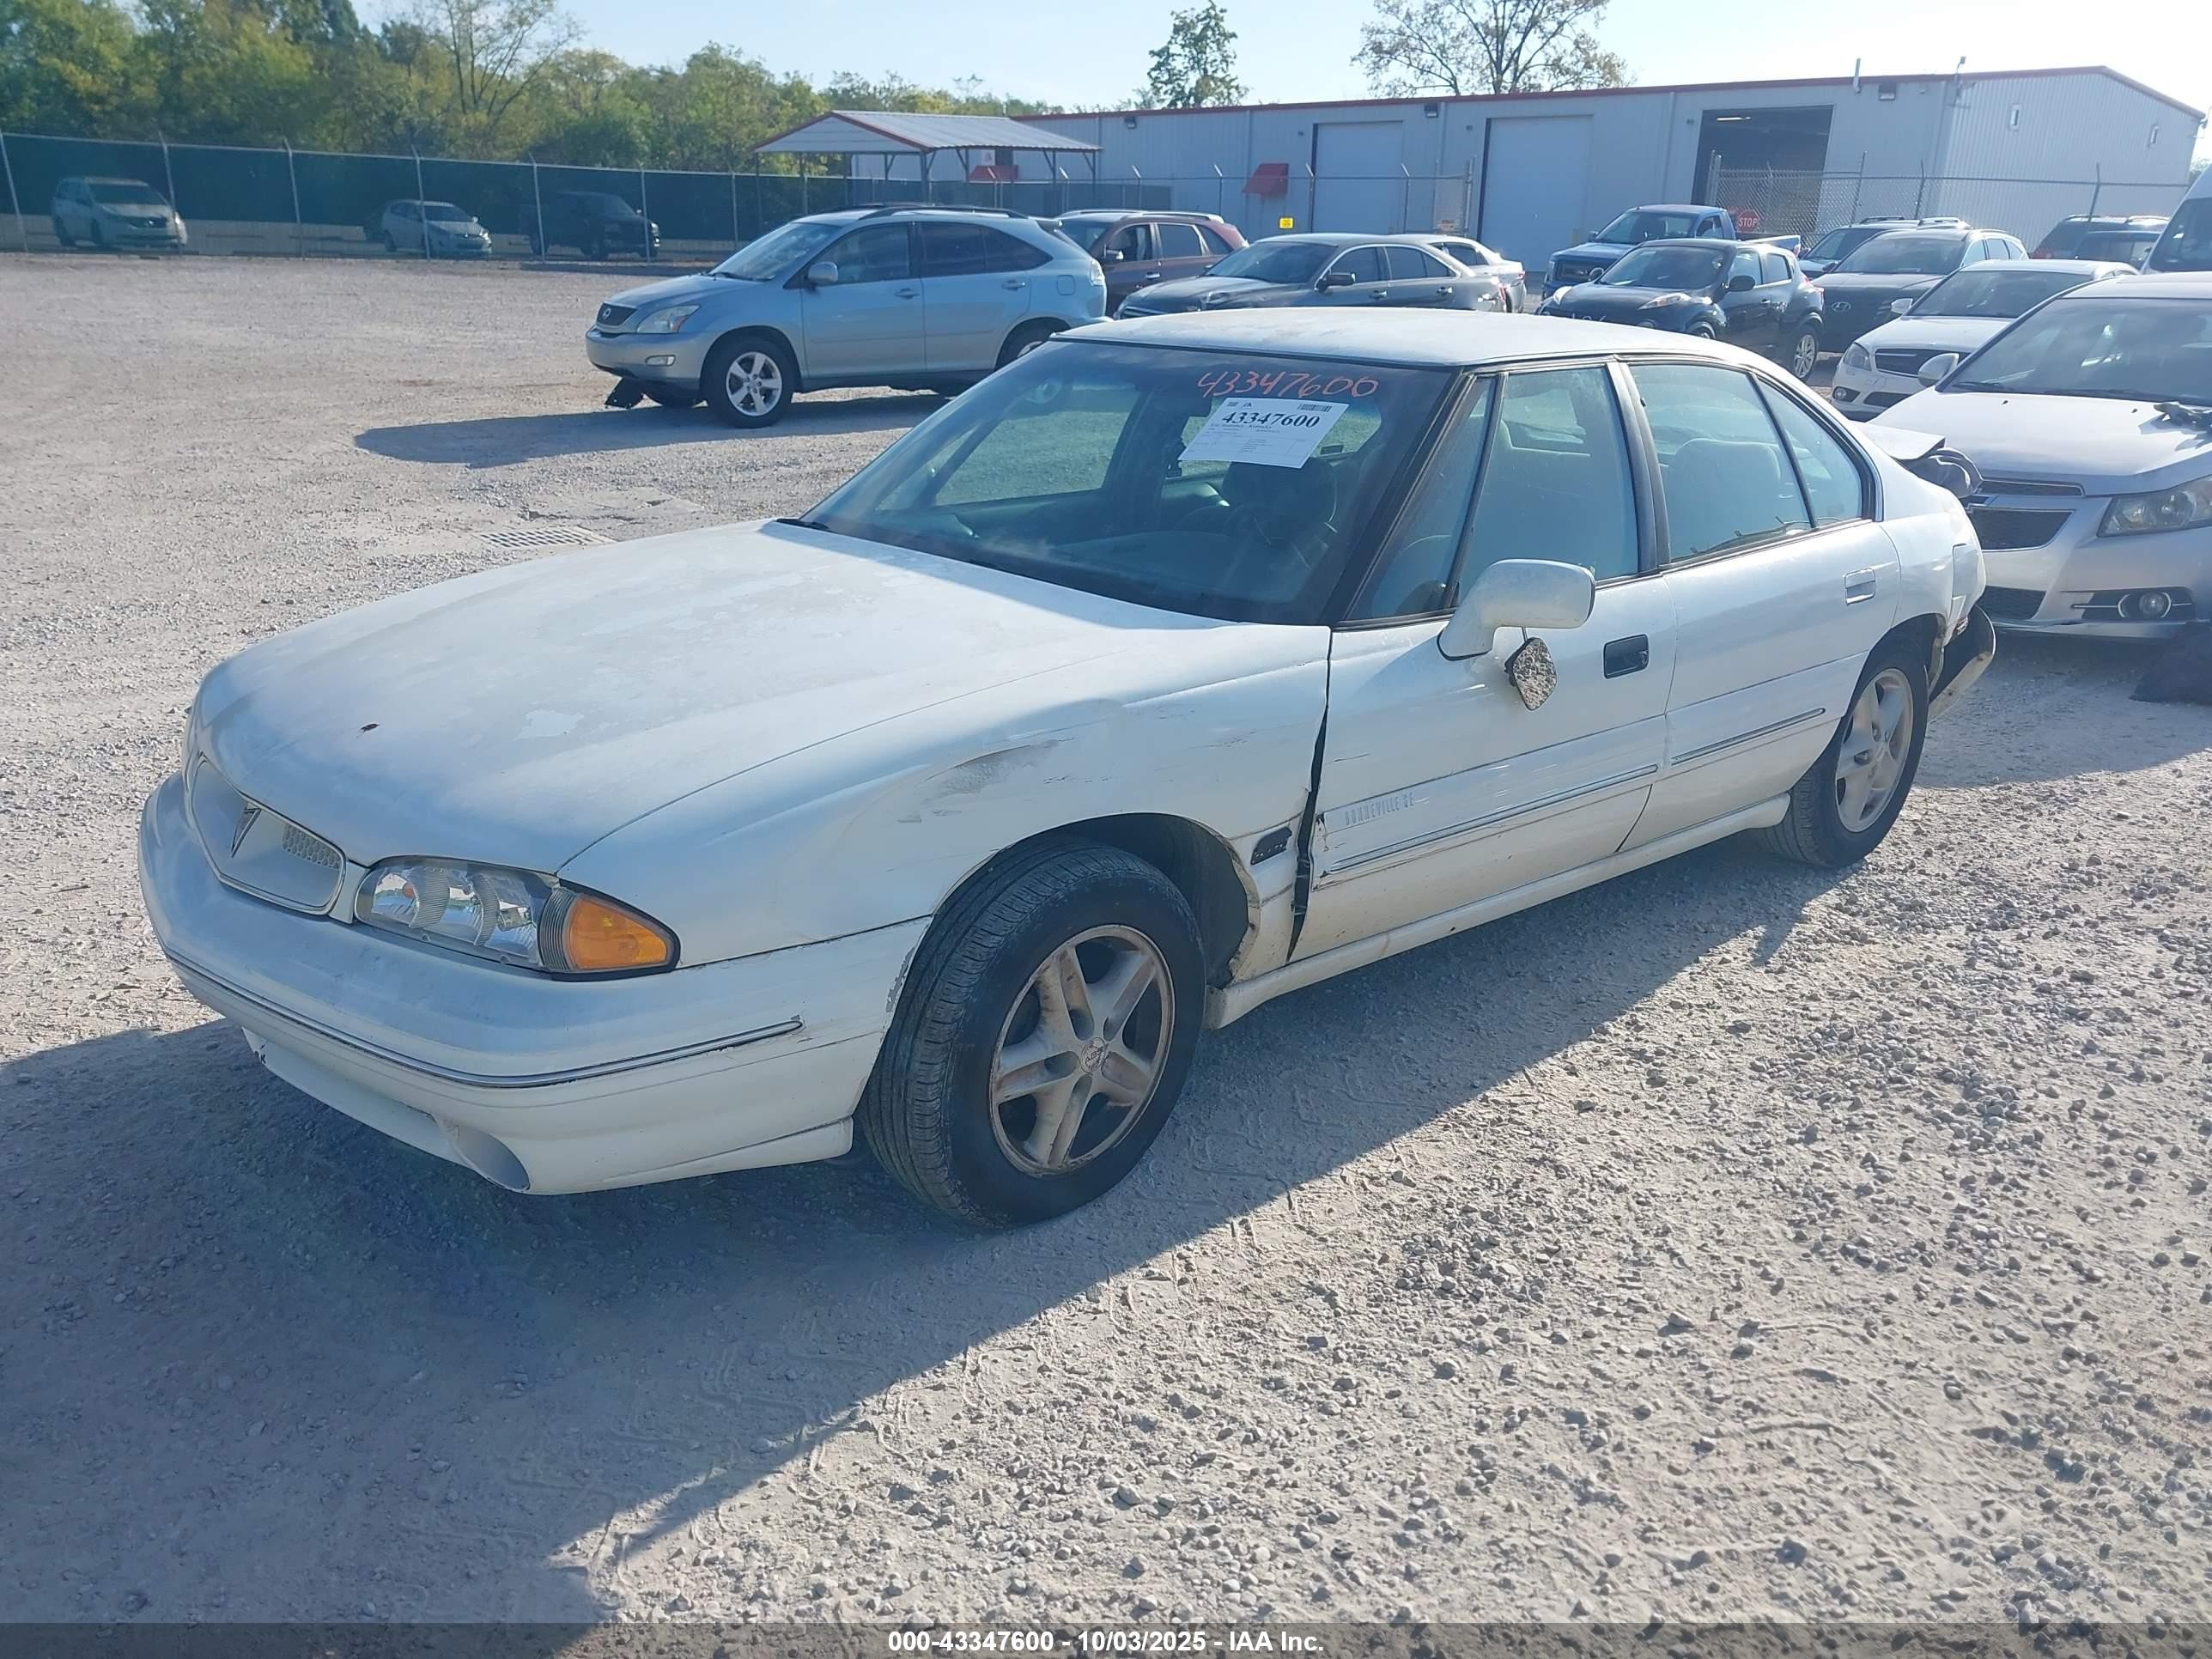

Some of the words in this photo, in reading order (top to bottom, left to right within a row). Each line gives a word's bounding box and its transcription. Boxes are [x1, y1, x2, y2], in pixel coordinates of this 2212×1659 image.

[1739, 217, 1758, 228] STOP
[1197, 371, 1379, 398] 43347600
[1222, 411, 1320, 428] 43347600
